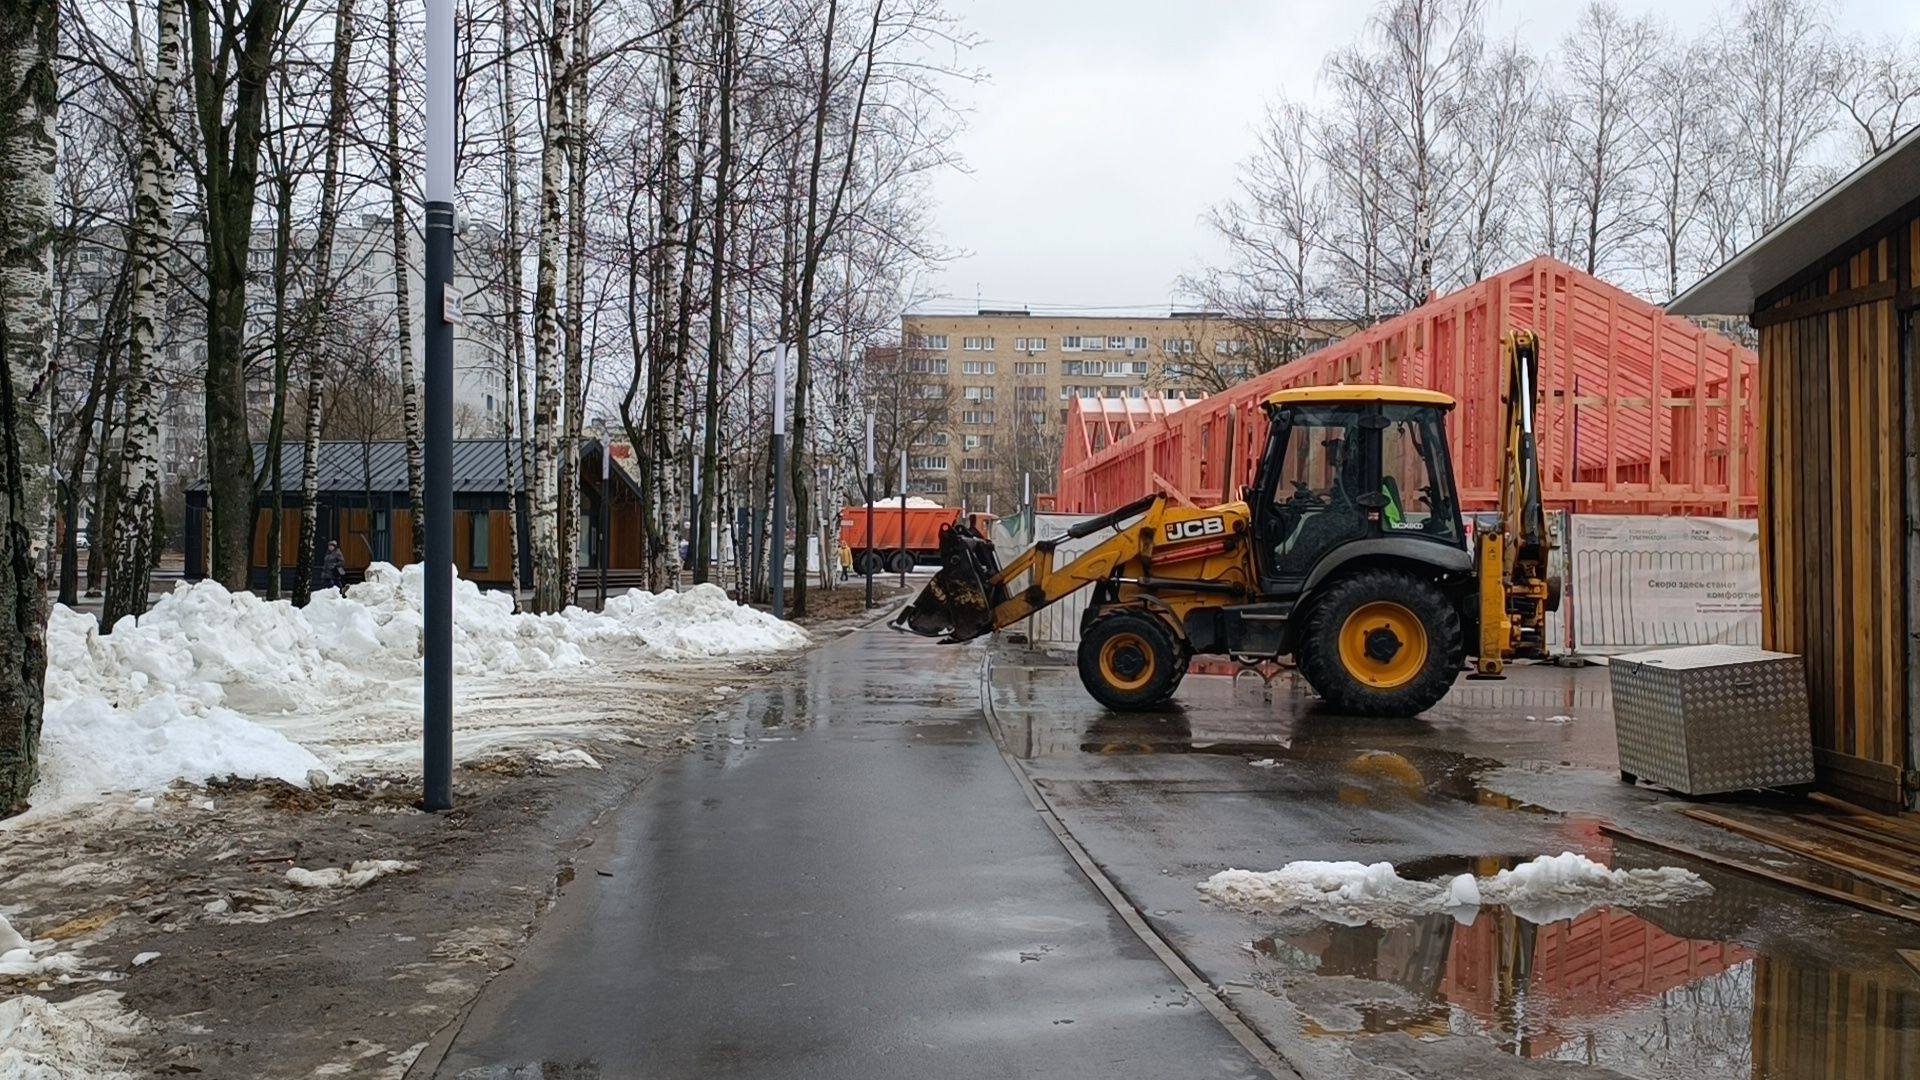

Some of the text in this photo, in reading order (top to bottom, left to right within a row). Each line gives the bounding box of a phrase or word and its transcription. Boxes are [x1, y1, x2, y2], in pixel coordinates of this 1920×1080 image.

[1167, 517, 1224, 540] JCB
[1648, 579, 1736, 589] Скоро здесь станет
